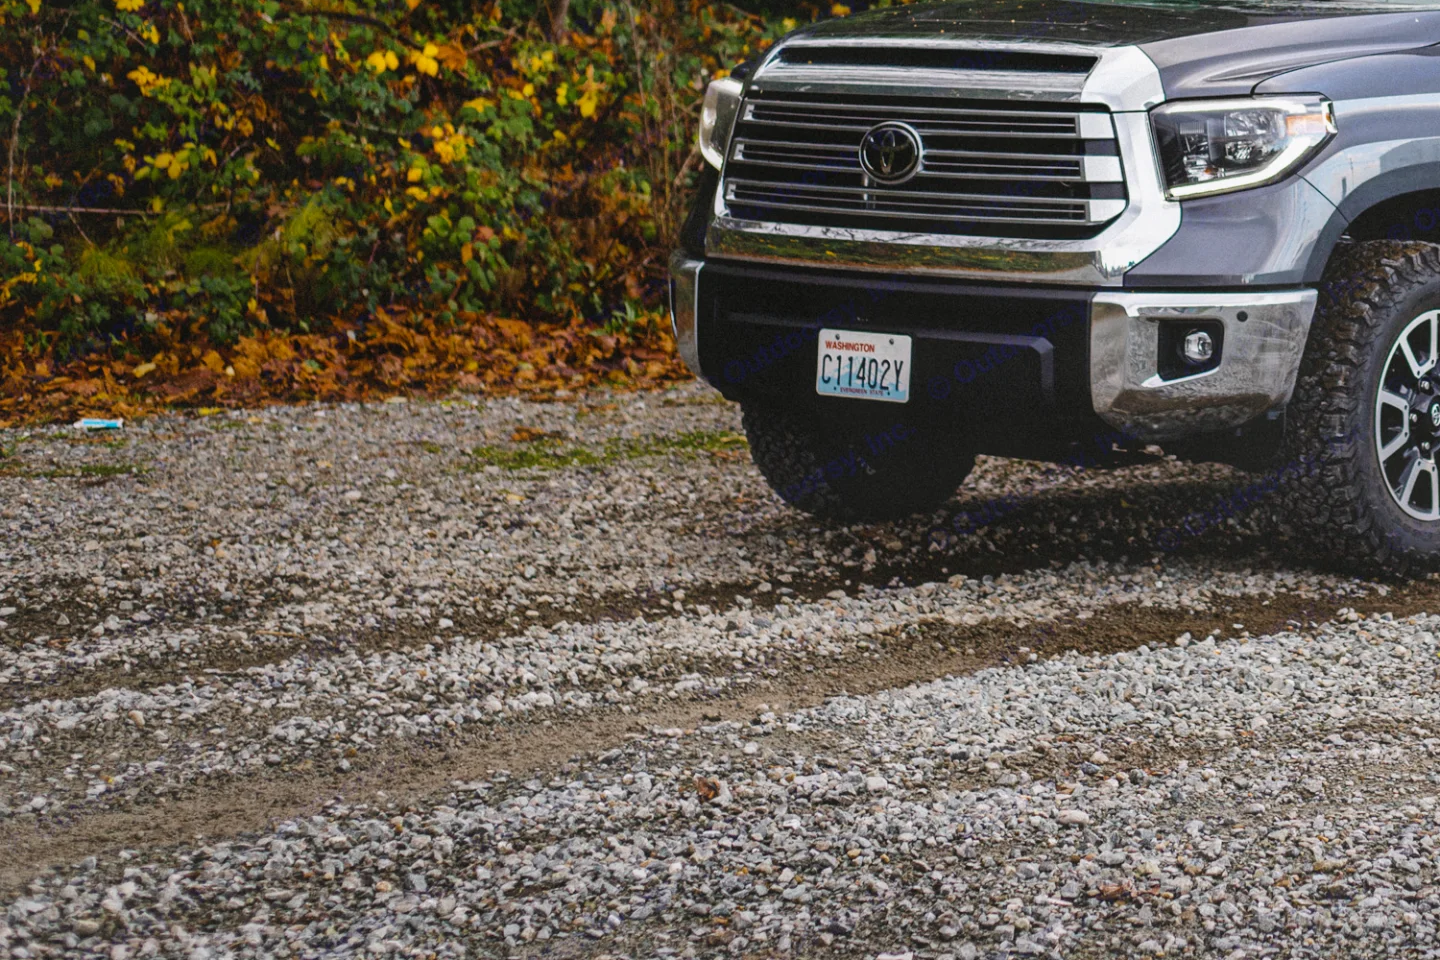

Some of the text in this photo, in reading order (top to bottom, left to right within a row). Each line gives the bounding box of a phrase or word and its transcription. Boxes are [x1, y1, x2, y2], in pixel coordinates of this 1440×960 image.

[825, 340, 876, 353] WASHINGTON
[821, 353, 904, 391] C11402Y
[840, 386, 868, 395] EVERGREEN
